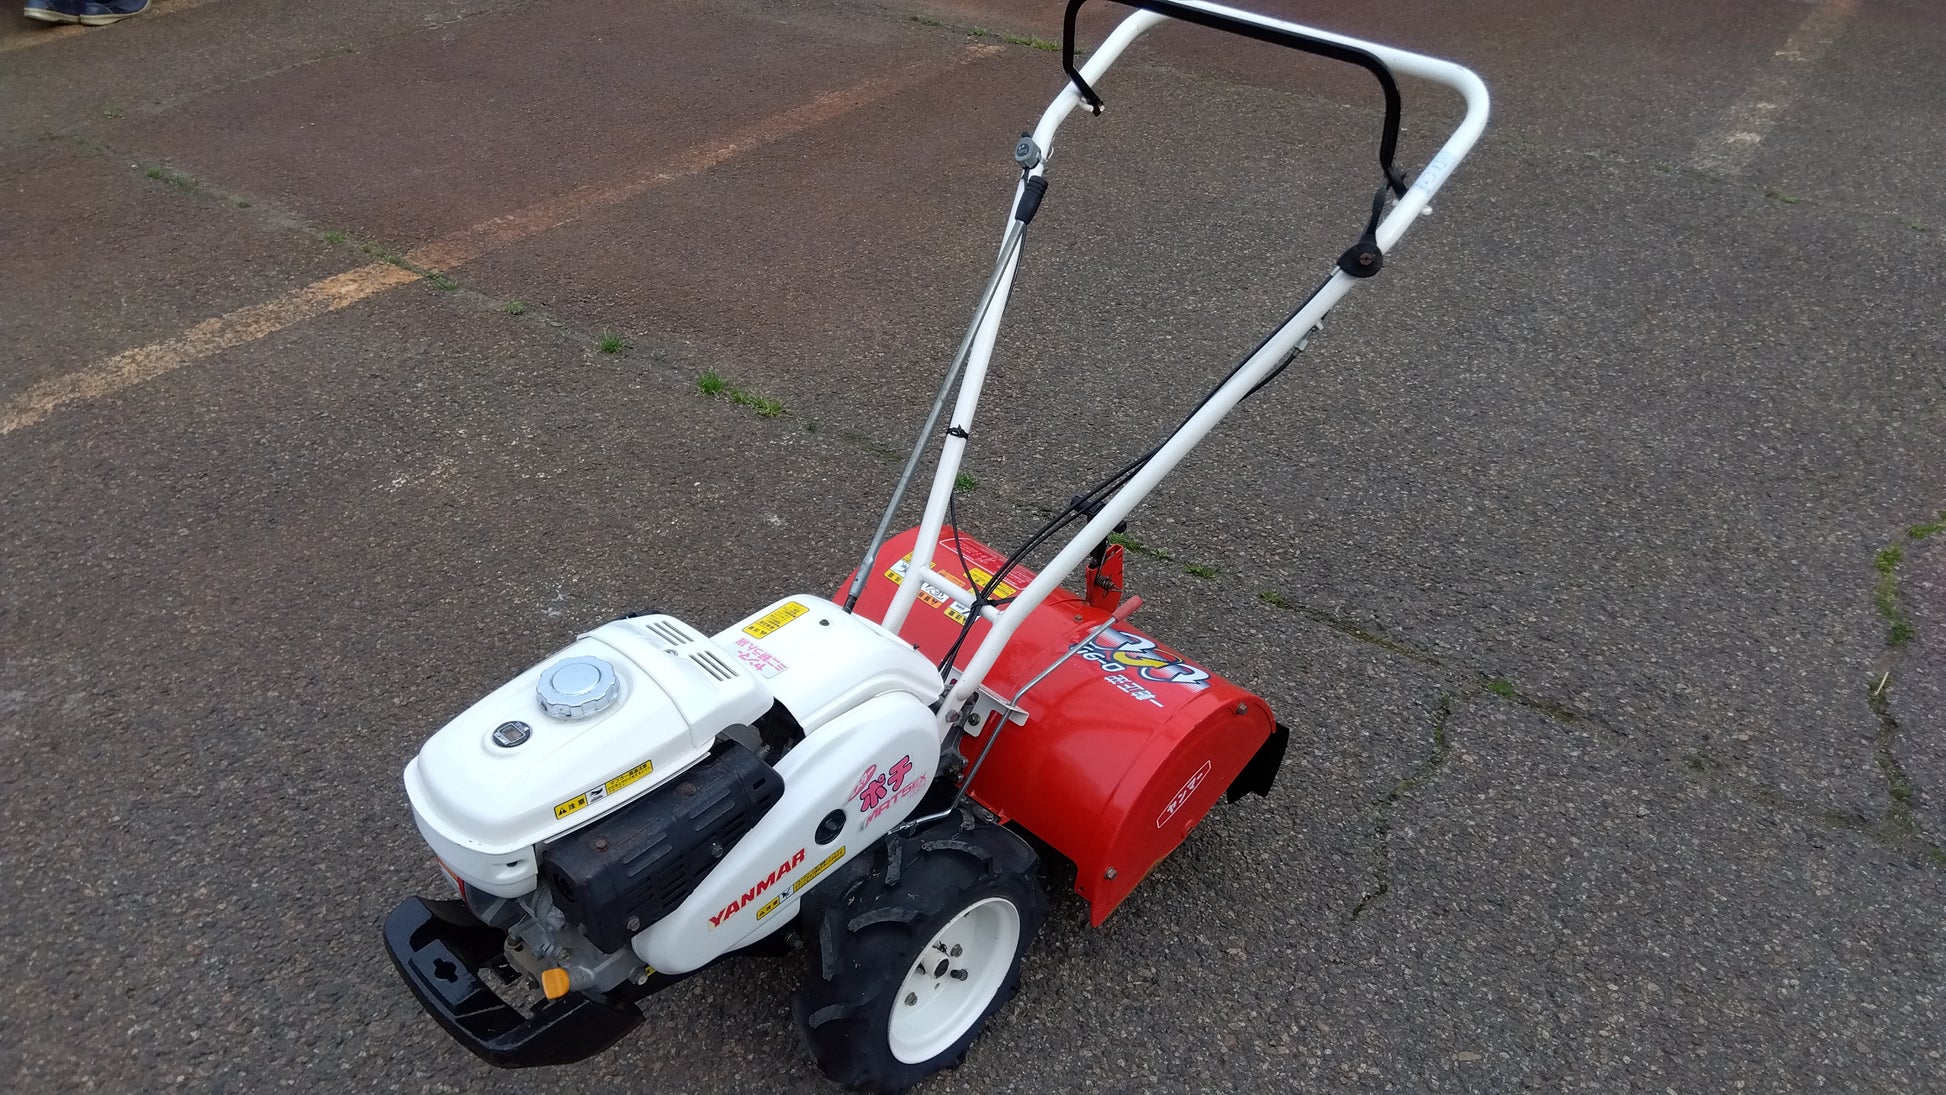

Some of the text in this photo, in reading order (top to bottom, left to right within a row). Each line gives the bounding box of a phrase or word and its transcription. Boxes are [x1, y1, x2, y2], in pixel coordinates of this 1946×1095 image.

[737, 650, 766, 671] ヤンマー
[860, 755, 912, 812] ポチ
[1167, 772, 1203, 813] ヤンマー
[709, 848, 805, 927] YANMAR
